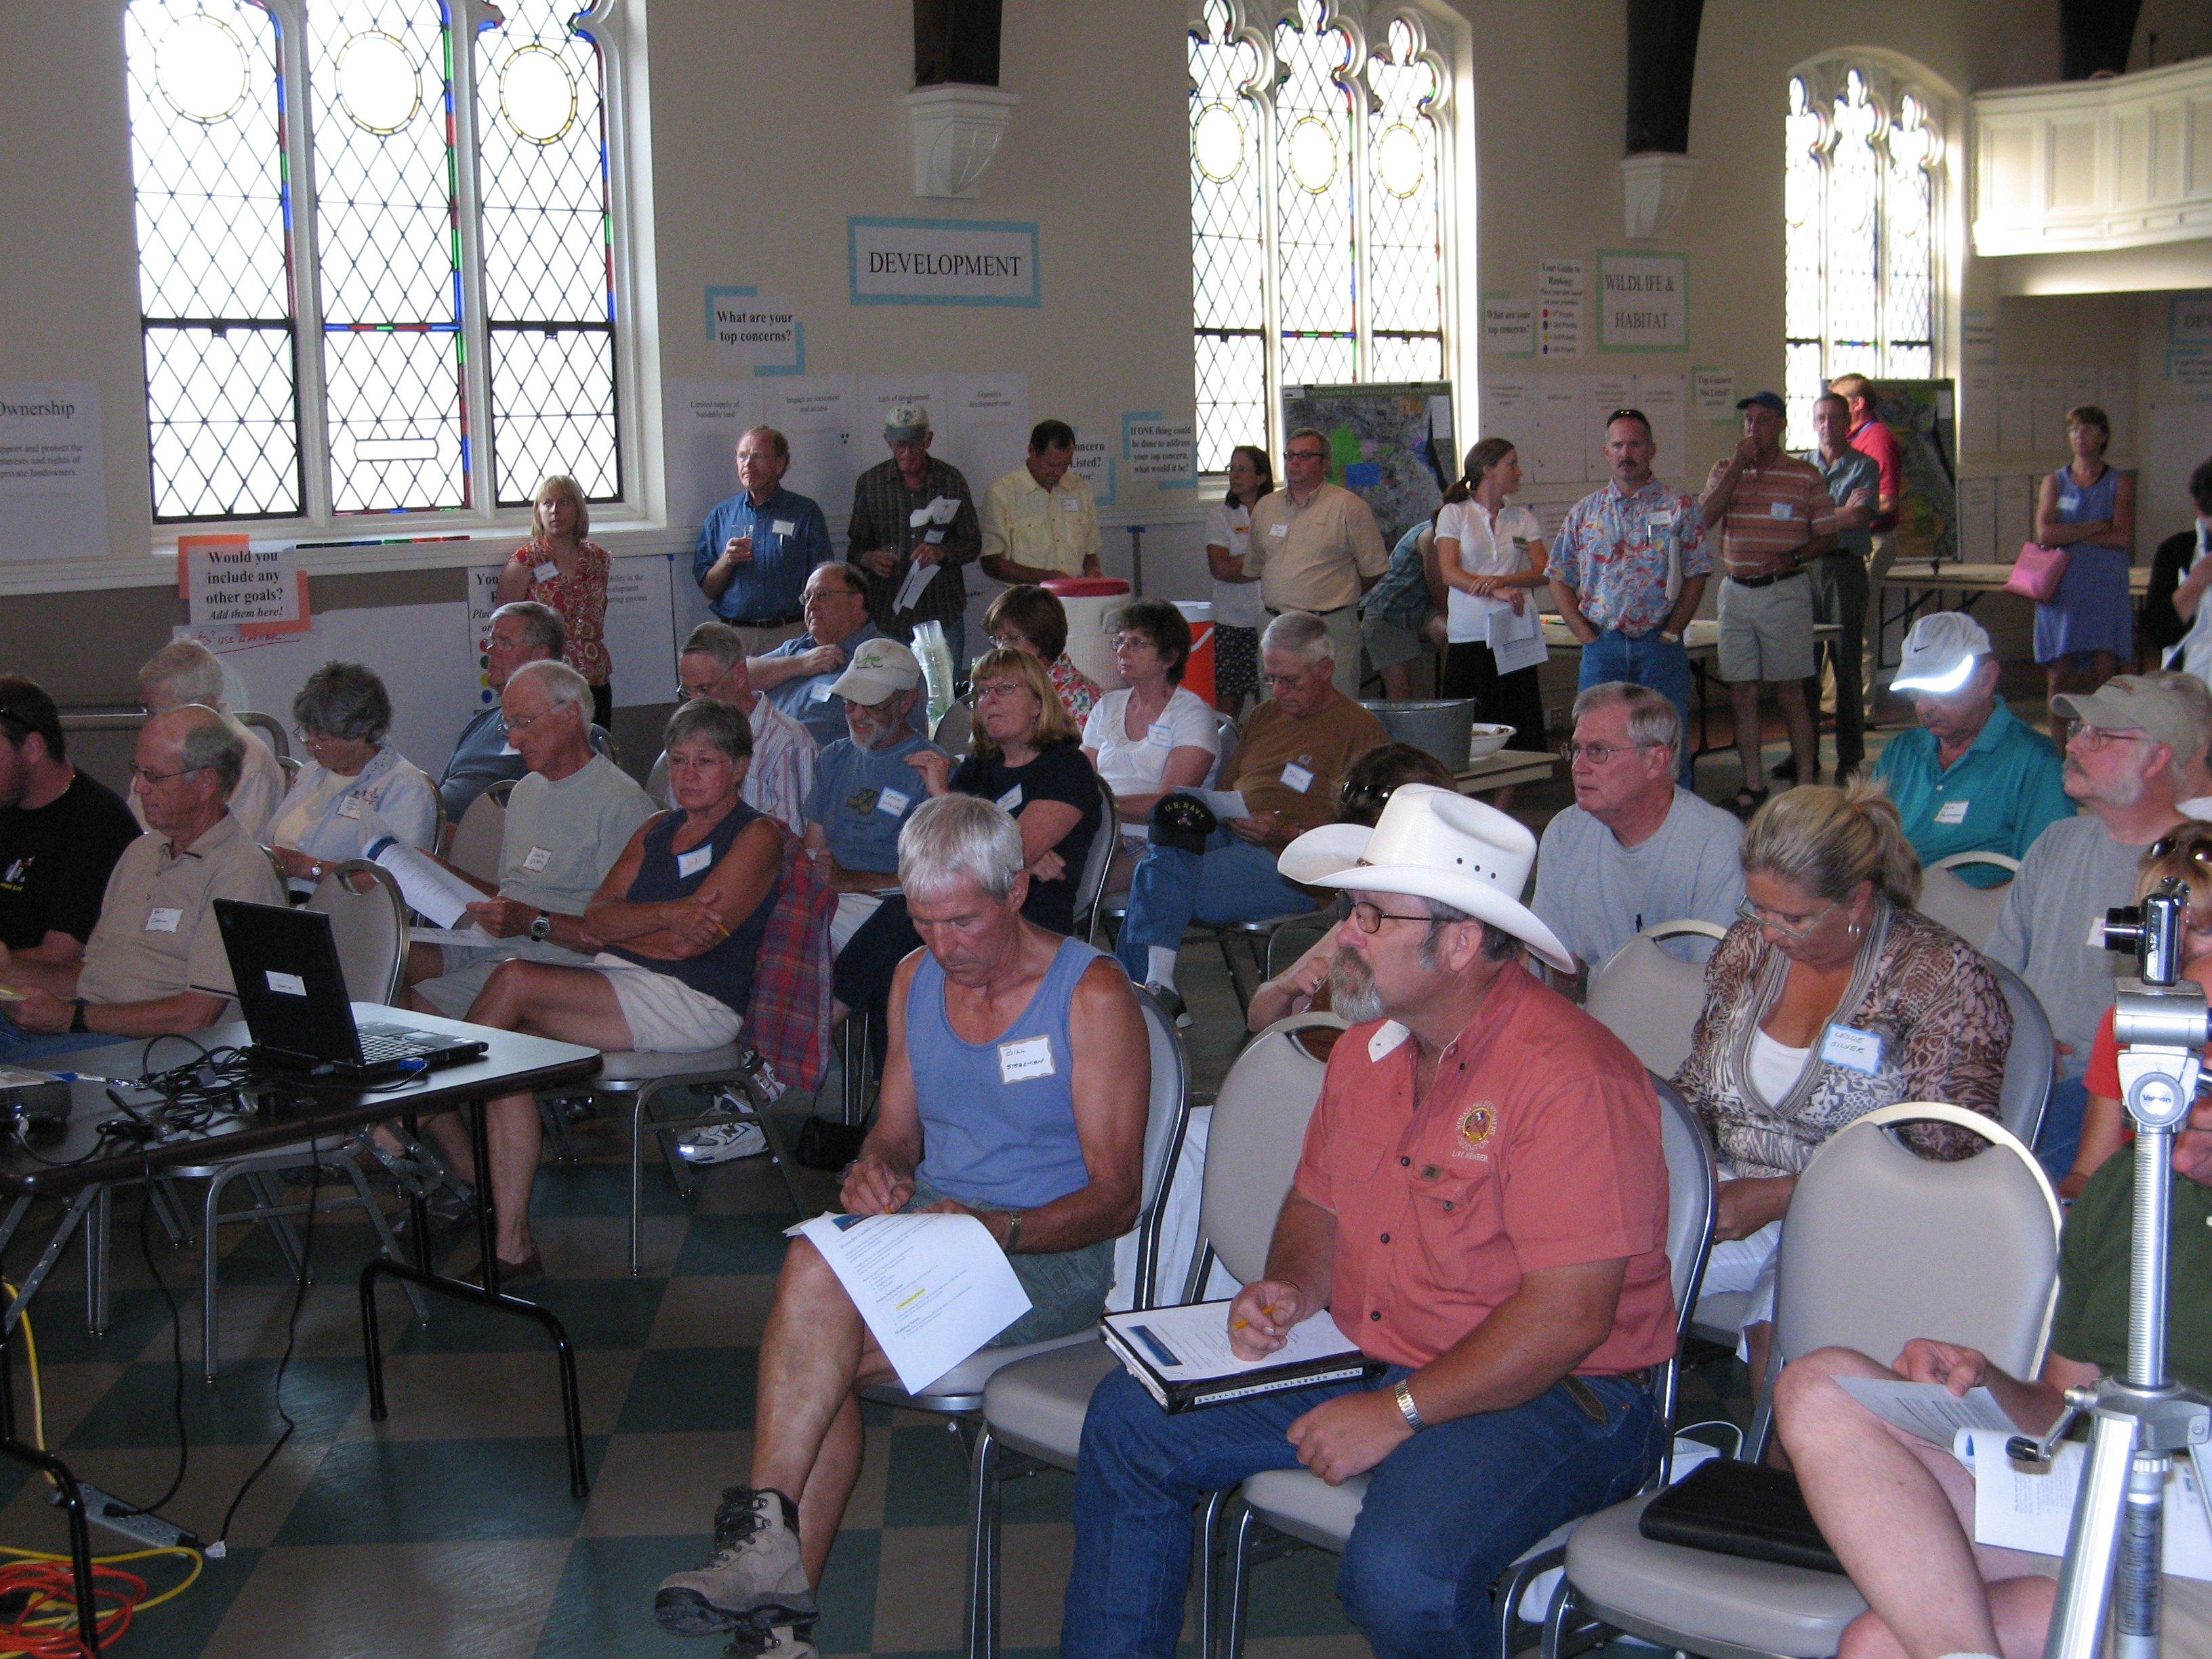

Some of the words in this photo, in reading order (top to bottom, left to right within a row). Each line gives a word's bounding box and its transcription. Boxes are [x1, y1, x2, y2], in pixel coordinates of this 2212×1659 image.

[869, 251, 1021, 276] DEVELOPMENT
[1605, 274, 1662, 291] WILDLIFE
[1665, 275, 1675, 291] &
[716, 311, 746, 323] What
[750, 314, 766, 323] are
[769, 314, 793, 326] your
[1616, 312, 1668, 329] HABITAT
[720, 331, 738, 344] top
[740, 329, 791, 342] concerns?
[1074, 443, 1105, 451] oncern
[208, 550, 251, 564] Would
[255, 552, 279, 565] you
[207, 570, 254, 584] include
[258, 571, 281, 584] any
[206, 591, 240, 605] other
[244, 588, 283, 605] goals?
[209, 610, 228, 621] Add
[231, 609, 255, 619] them
[258, 607, 283, 617] here!
[1183, 802, 1205, 819] NAVY
[1830, 1042, 1866, 1054] SILVER
